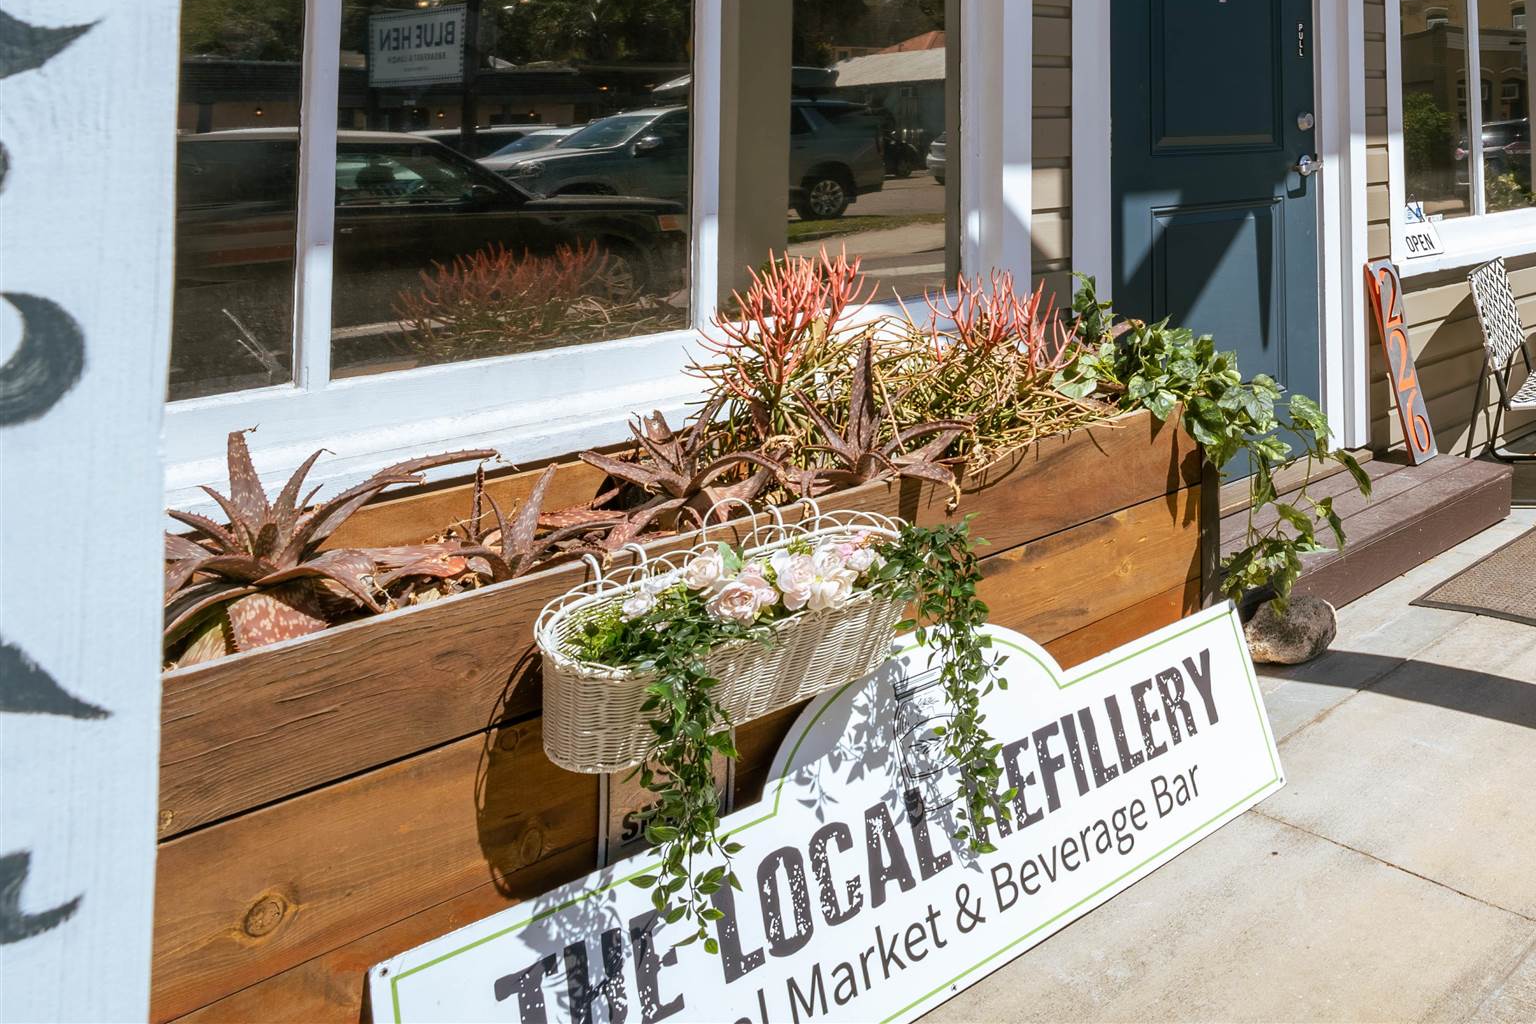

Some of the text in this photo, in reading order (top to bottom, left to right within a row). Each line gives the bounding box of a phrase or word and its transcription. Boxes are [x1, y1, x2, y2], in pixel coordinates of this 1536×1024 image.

[1405, 233, 1436, 252] OPEN
[1375, 266, 1431, 454] 226
[494, 902, 686, 1024] THE
[708, 787, 953, 985] LOCAL
[786, 903, 947, 1024] Market
[955, 882, 986, 935] &
[990, 797, 1149, 914] Beverage
[1151, 762, 1202, 820] Bar
